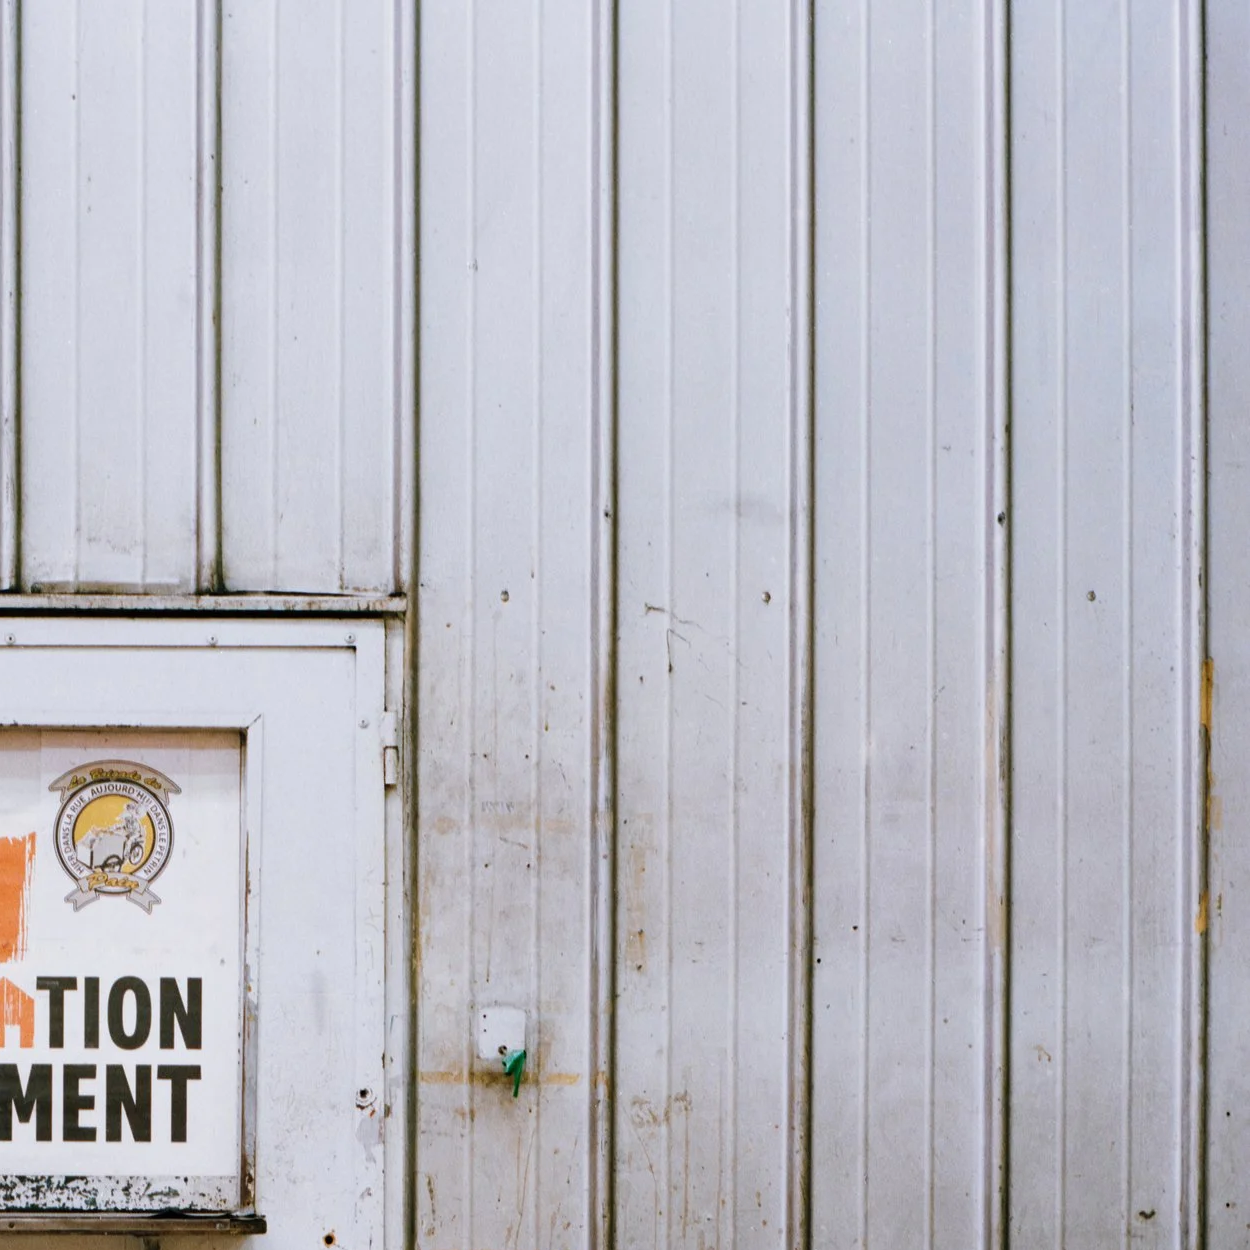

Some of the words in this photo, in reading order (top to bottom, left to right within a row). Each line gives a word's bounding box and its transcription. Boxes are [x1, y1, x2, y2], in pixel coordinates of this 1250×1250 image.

[64, 813, 74, 825] LA
[150, 805, 166, 832] DANS
[62, 826, 72, 852] DANS
[158, 832, 167, 843] LE
